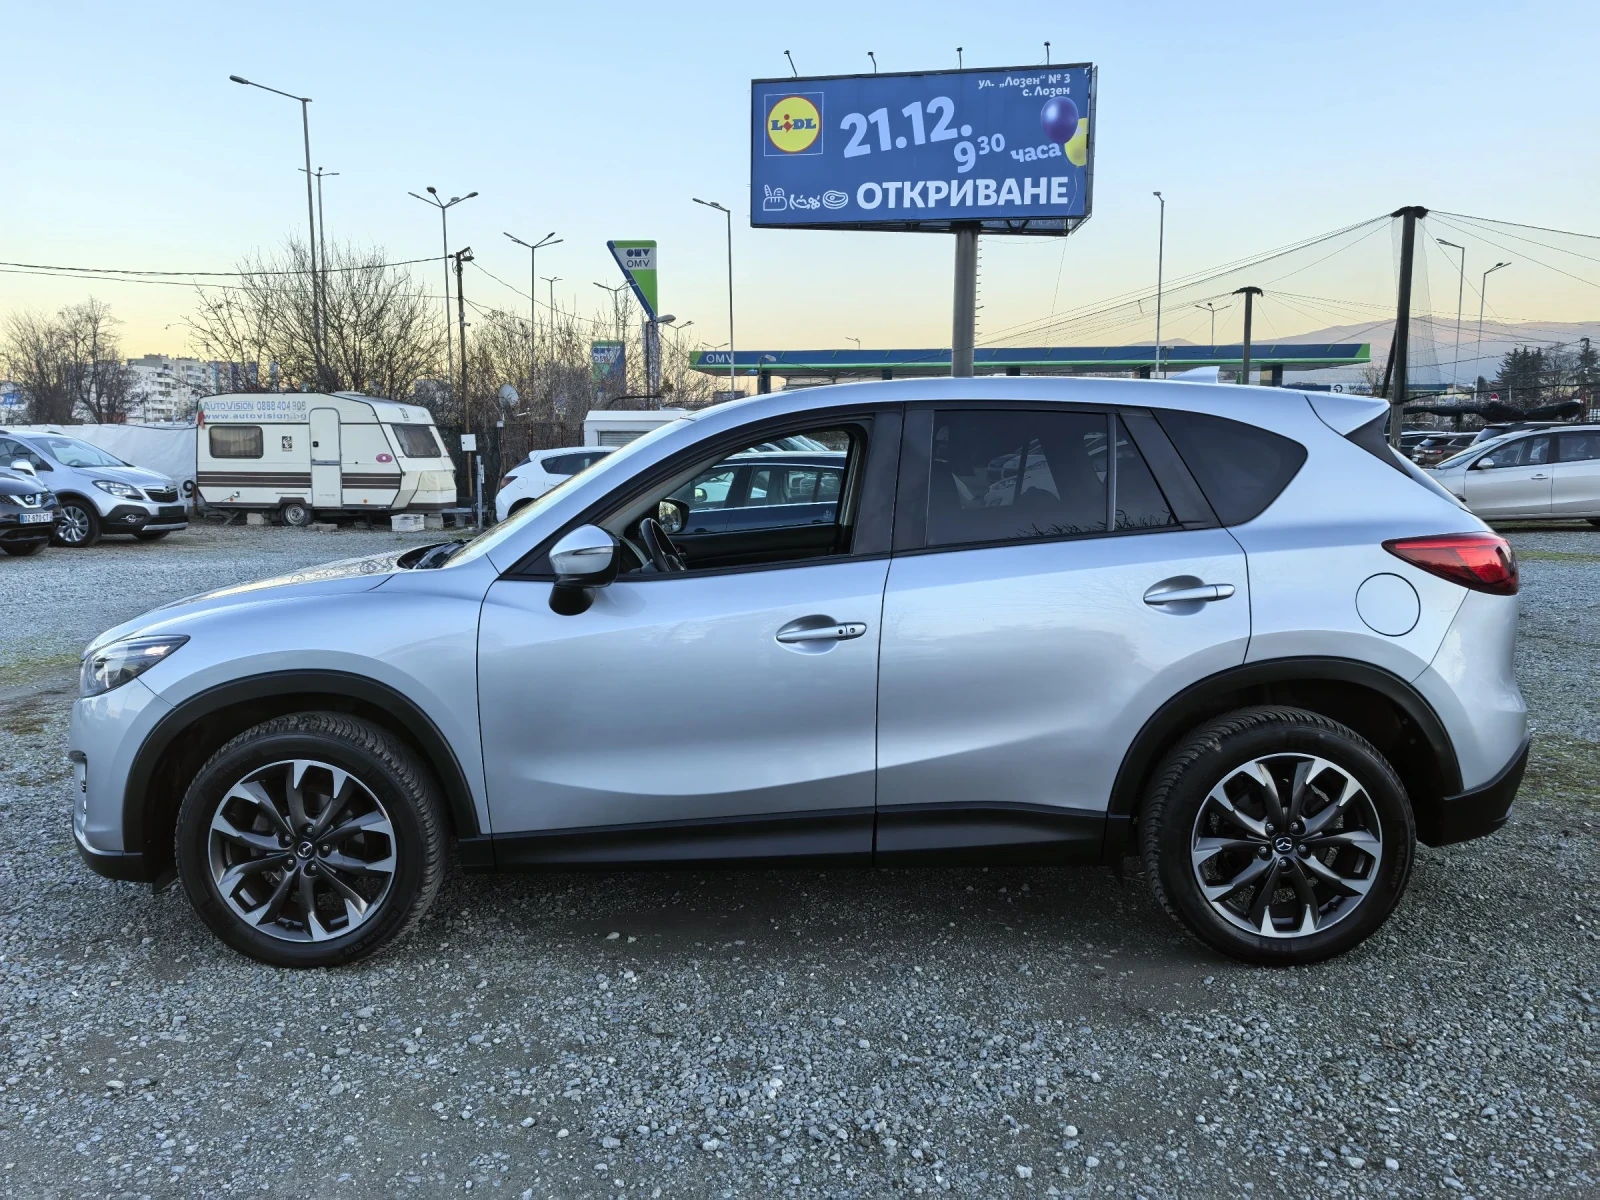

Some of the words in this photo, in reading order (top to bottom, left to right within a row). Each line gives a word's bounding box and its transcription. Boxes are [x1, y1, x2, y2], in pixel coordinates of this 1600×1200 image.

[978, 79, 995, 90] ул.
[1064, 73, 1071, 84] 3
[1022, 88, 1032, 97] с.
[1034, 86, 1070, 97] Лозен
[839, 96, 973, 158] 21.12.
[1010, 143, 1062, 163] часа
[856, 176, 1069, 210] ОТКРИВАНЕ
[626, 259, 650, 268] OMV
[256, 401, 276, 411] 0888
[277, 401, 291, 411] 404
